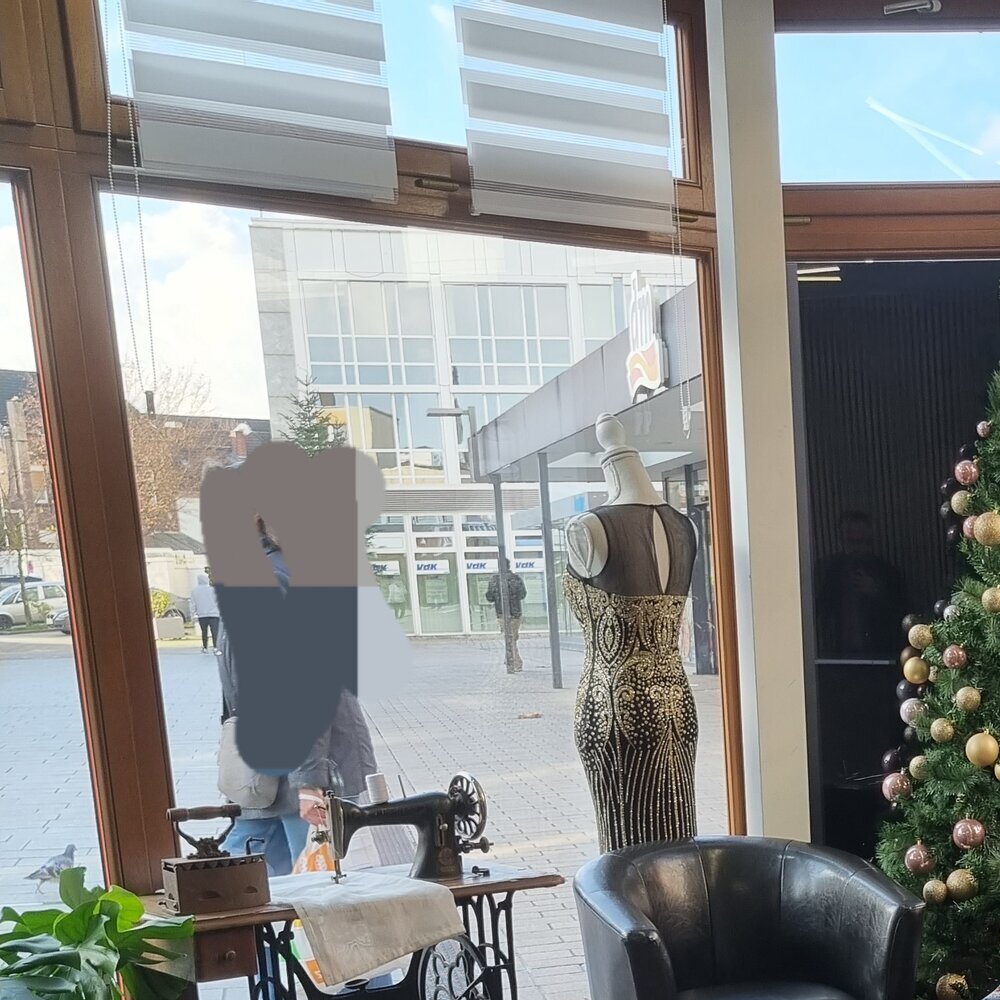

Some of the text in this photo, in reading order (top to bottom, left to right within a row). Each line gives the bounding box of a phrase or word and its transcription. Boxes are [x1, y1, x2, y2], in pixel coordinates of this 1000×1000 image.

[416, 563, 438, 571] VdK
[466, 562, 487, 570] VdK
[515, 561, 535, 569] VdK
